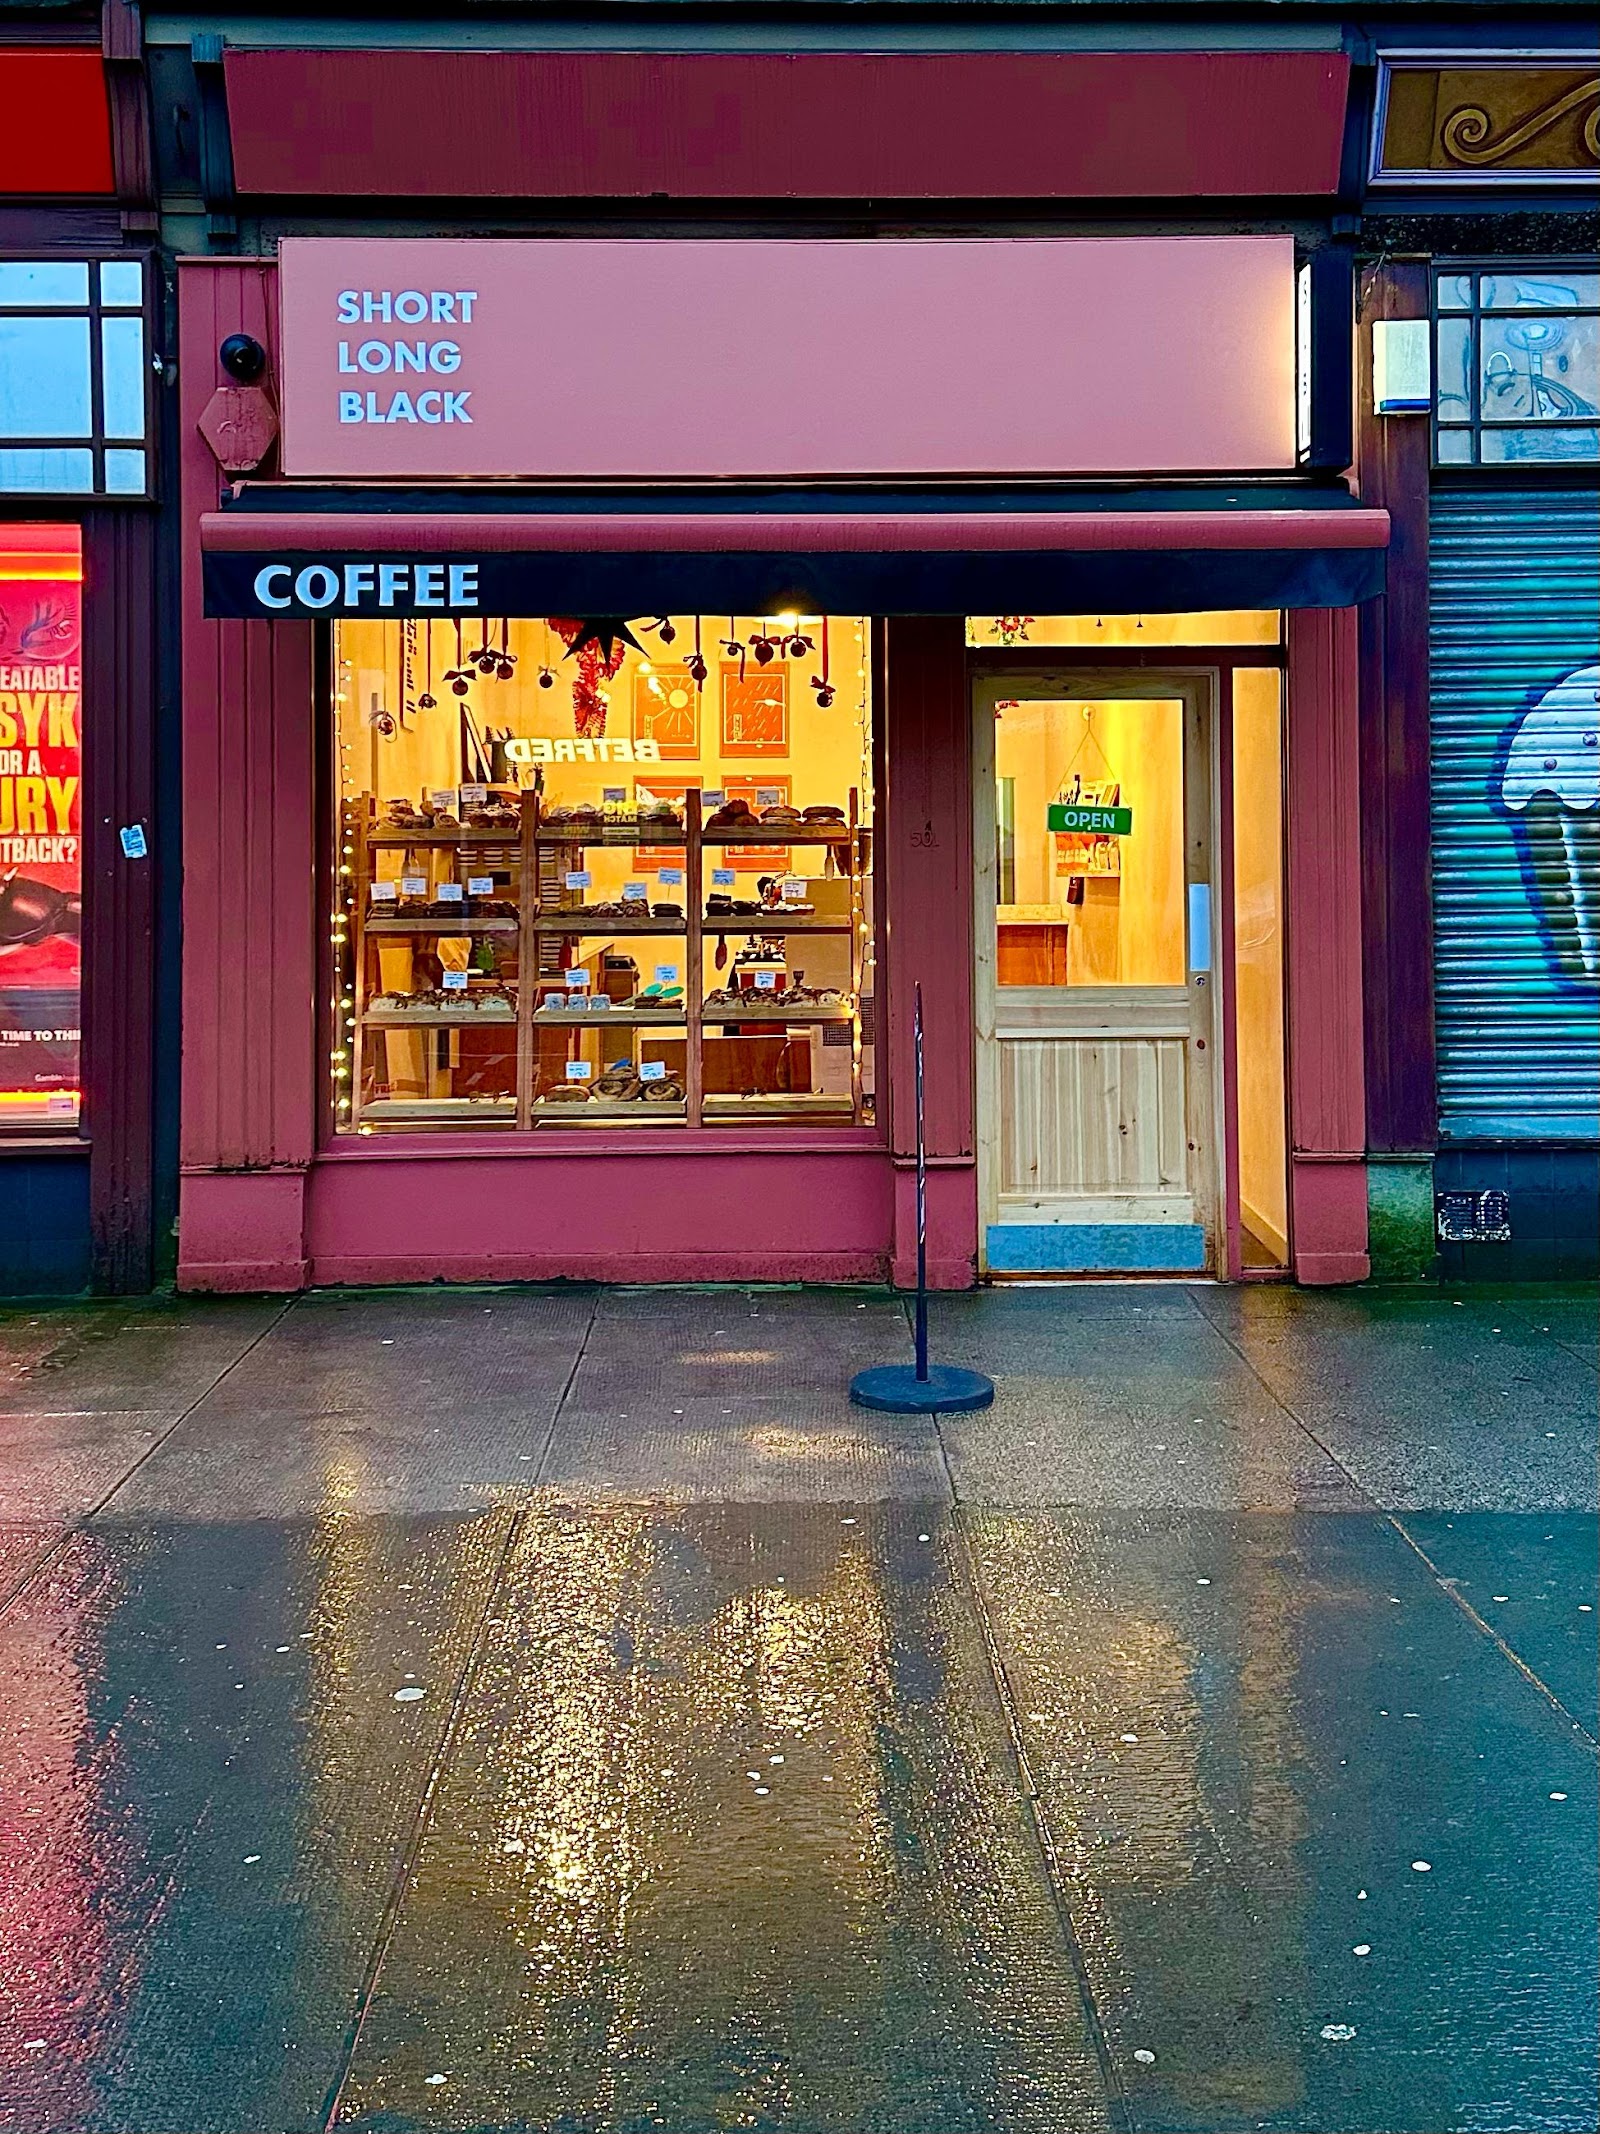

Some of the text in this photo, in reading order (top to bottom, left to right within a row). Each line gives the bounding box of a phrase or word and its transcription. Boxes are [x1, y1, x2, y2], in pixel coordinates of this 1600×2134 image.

[337, 290, 477, 324] SHORT
[338, 341, 462, 374] LONG
[339, 391, 473, 424] BLACK
[254, 564, 479, 608] COFFEE
[27, 749, 42, 775] A
[1064, 811, 1115, 829] OPEN
[1, 1029, 32, 1041] TIME
[33, 1029, 53, 1041] TO
